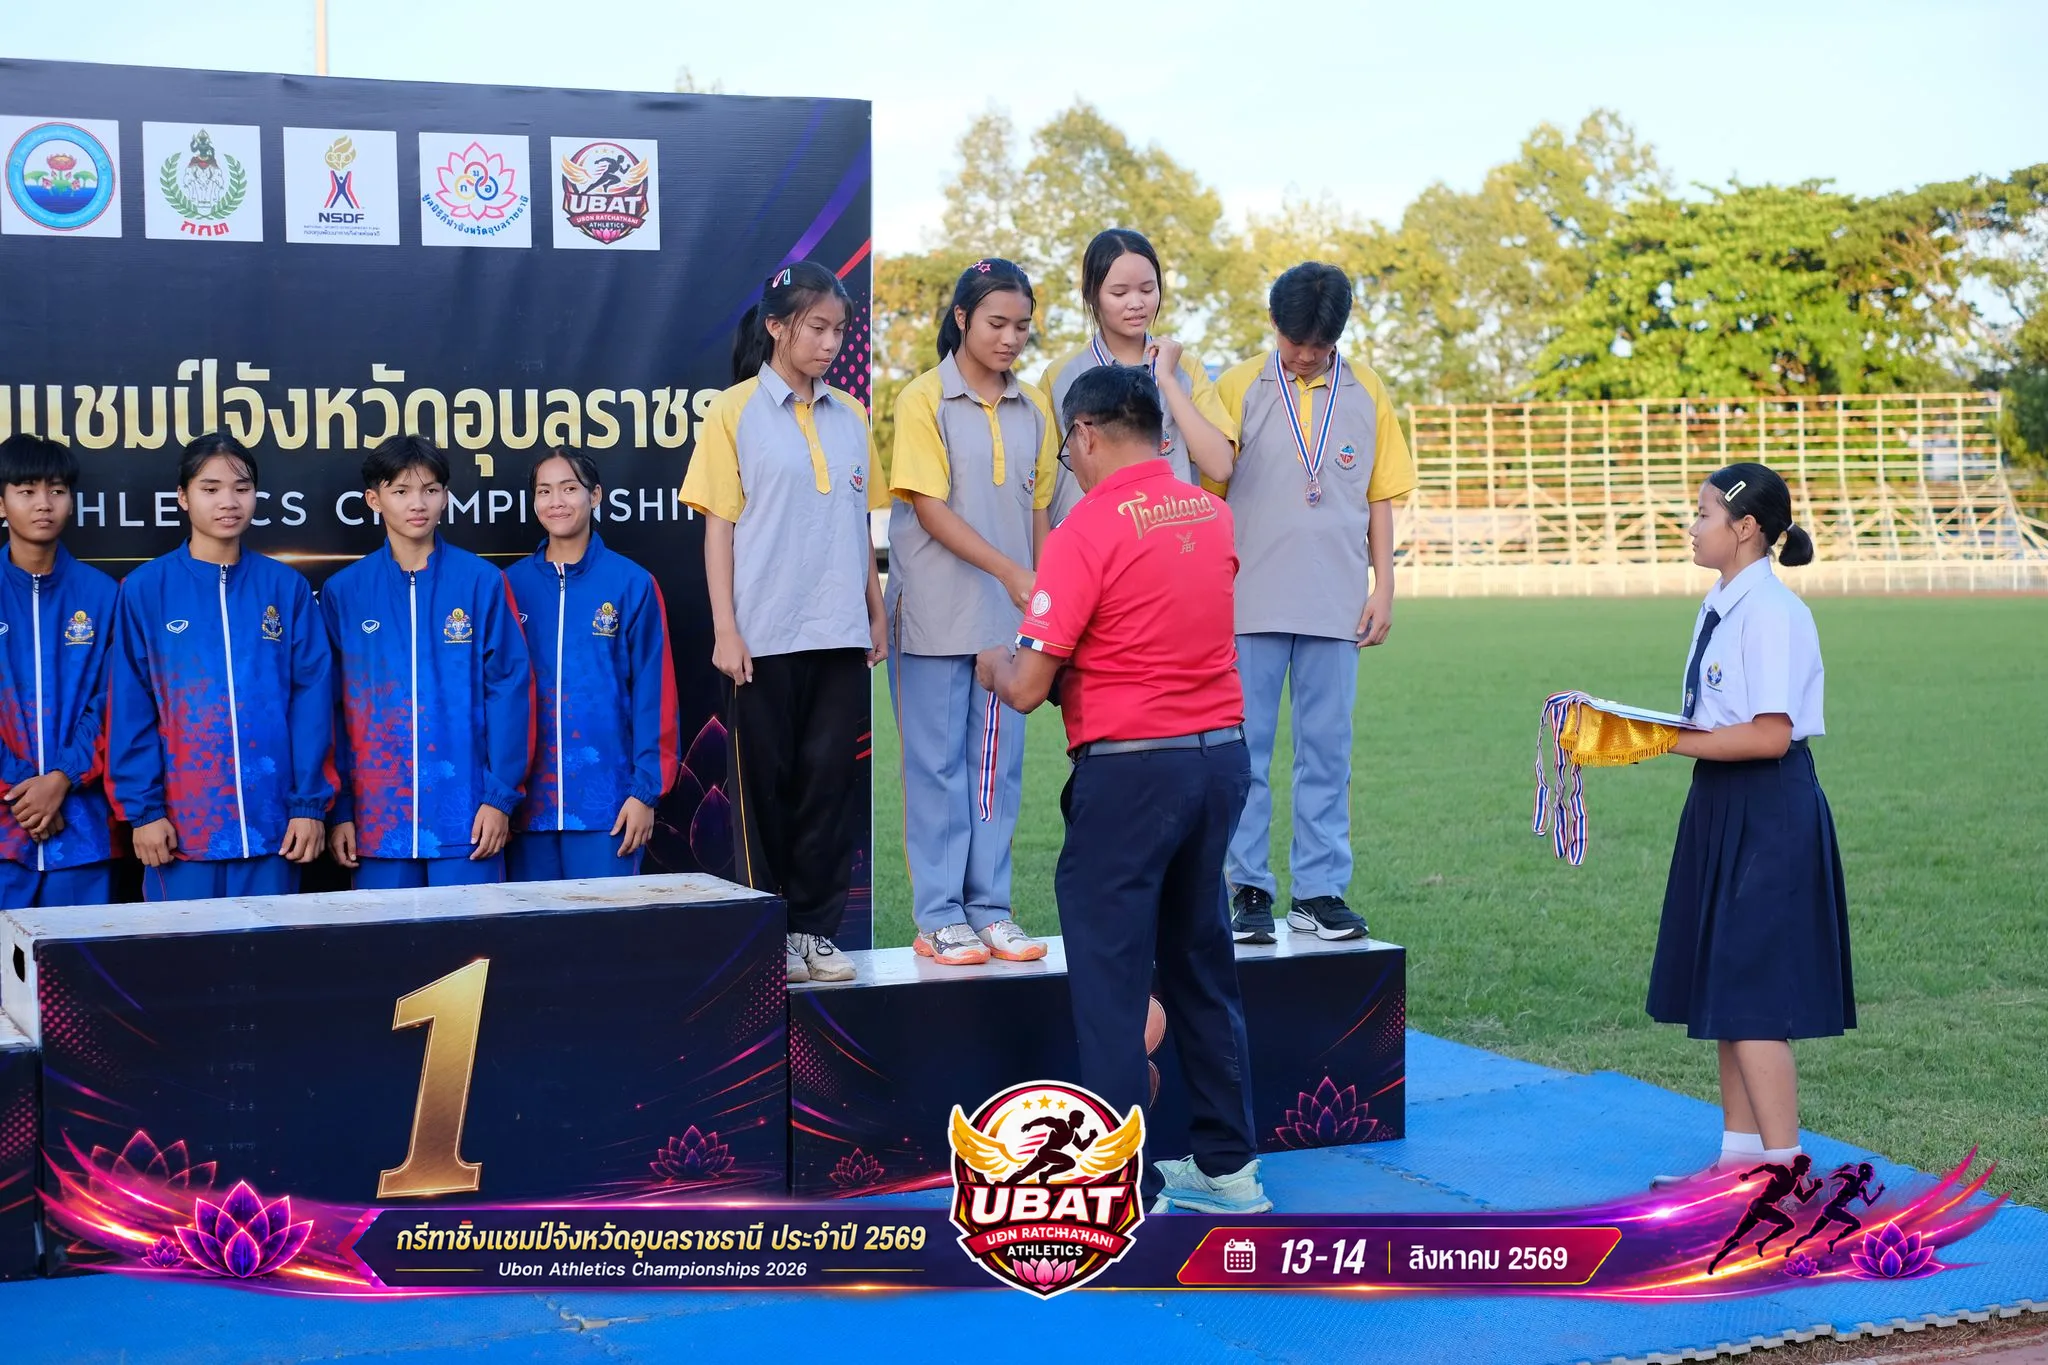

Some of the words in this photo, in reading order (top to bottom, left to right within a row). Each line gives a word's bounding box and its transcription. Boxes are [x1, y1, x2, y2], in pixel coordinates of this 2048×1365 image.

[569, 195, 642, 215] UBAT
[318, 212, 364, 224] NSDF
[588, 221, 625, 229] ATHLETICS
[180, 220, 230, 237] กกท
[1117, 490, 1216, 540] Thailand
[377, 958, 490, 1198] 1
